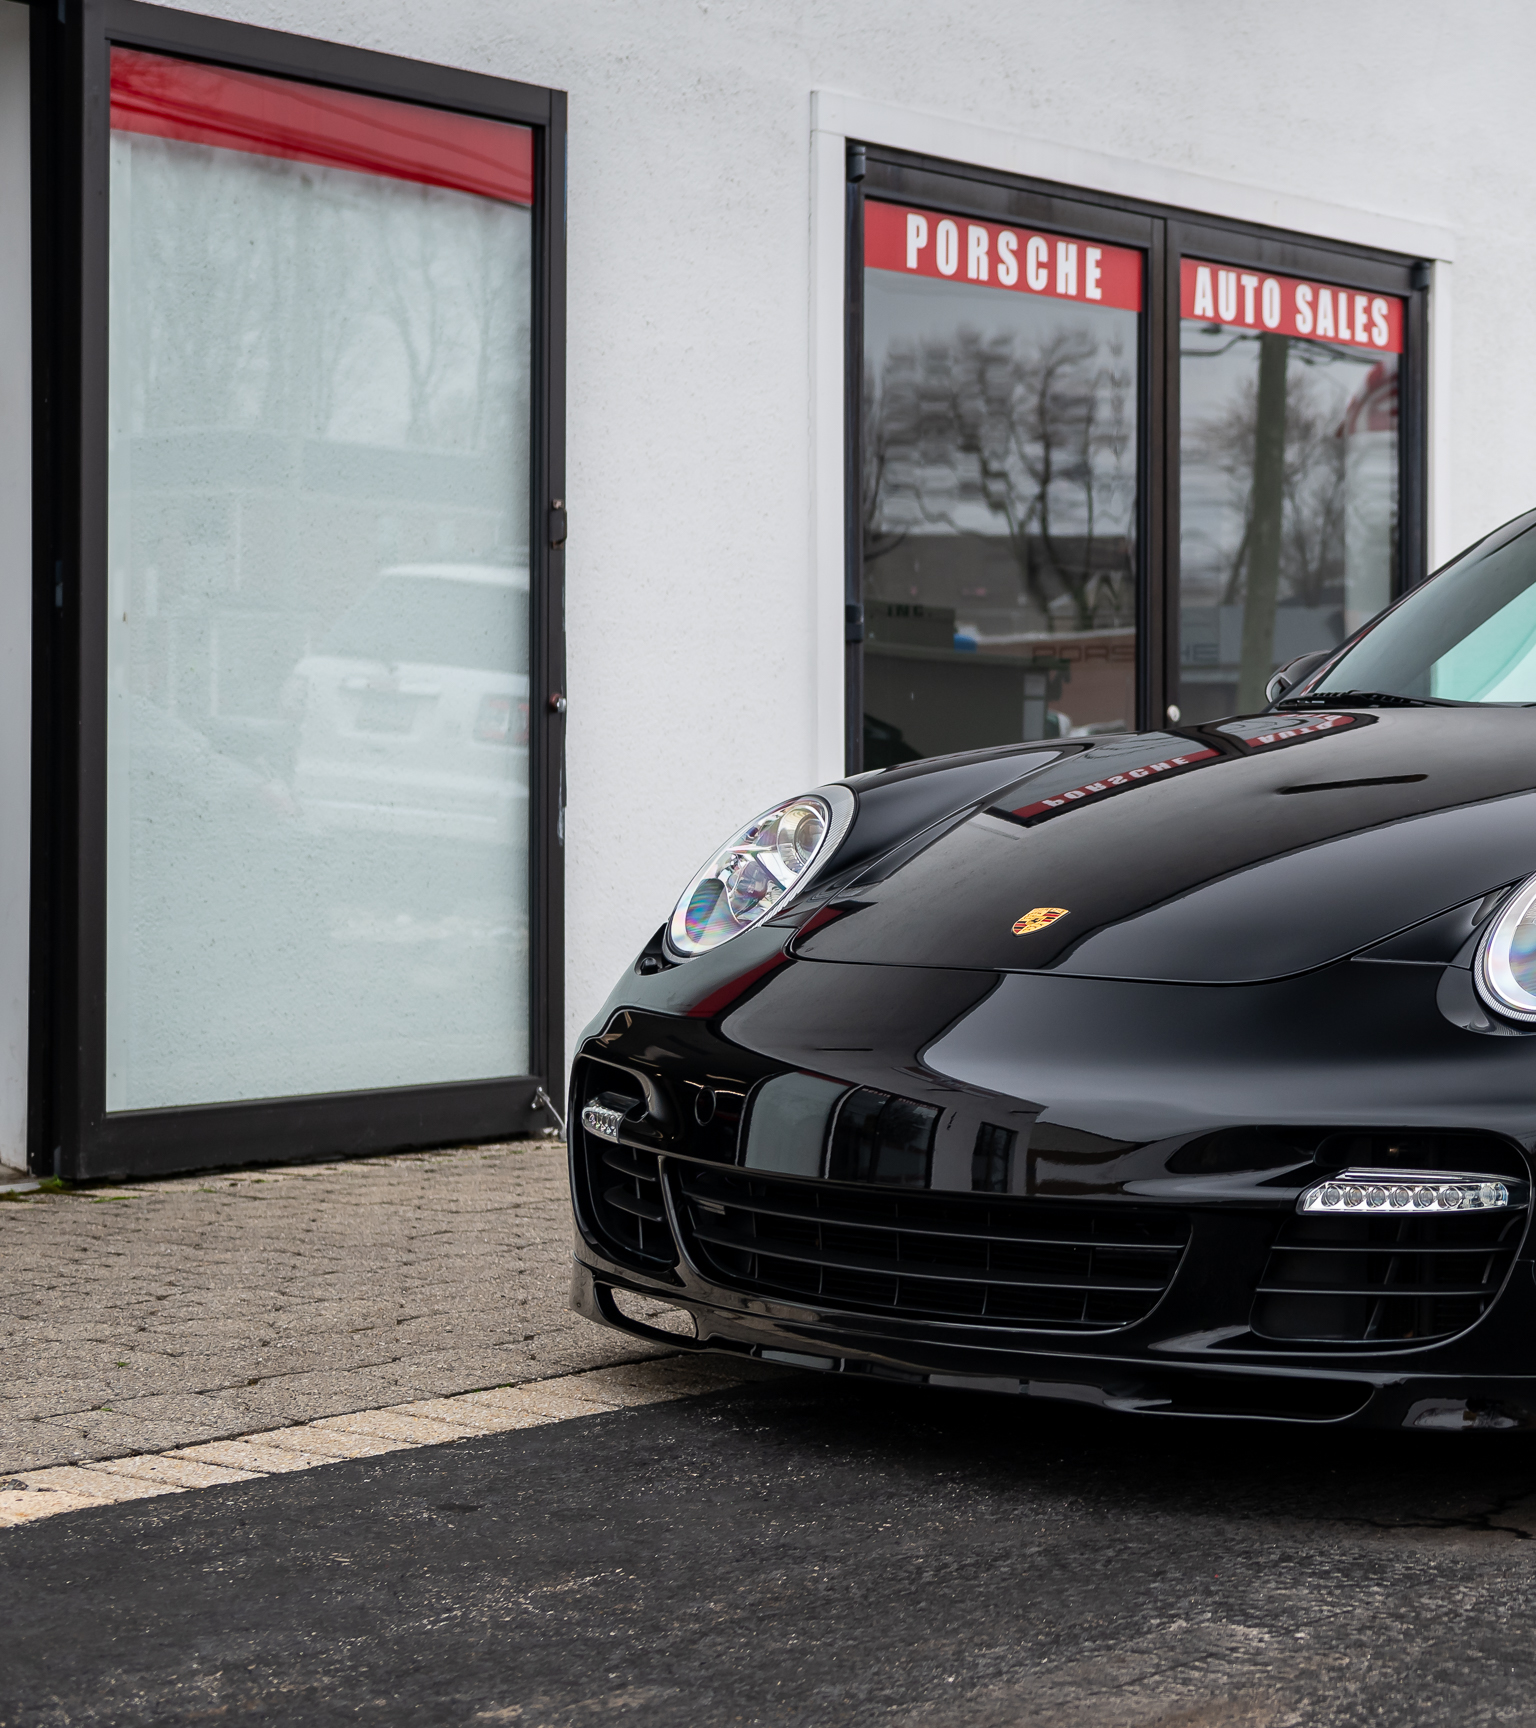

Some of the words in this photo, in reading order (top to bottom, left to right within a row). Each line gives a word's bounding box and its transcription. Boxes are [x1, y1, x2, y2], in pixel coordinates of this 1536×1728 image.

[905, 213, 1102, 300] PORSCHE
[1193, 266, 1282, 330] AUTO
[1294, 284, 1389, 348] SALES
